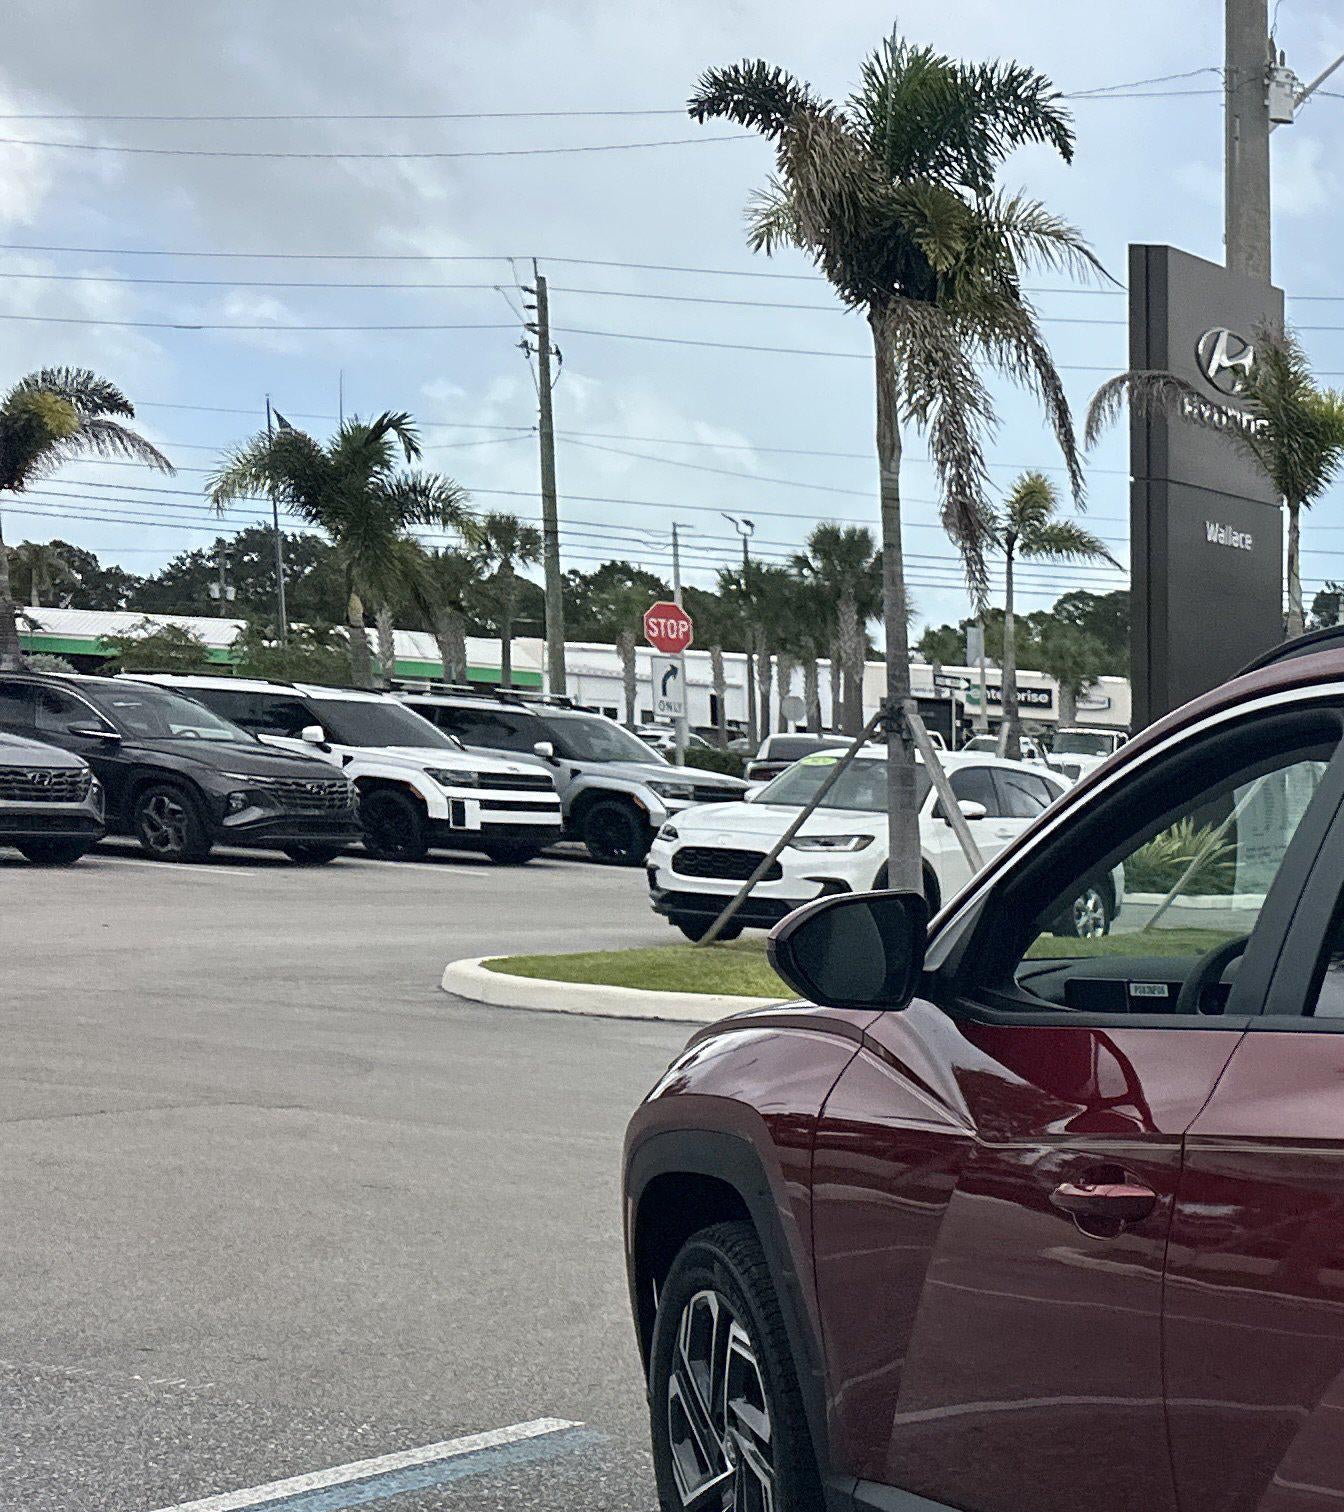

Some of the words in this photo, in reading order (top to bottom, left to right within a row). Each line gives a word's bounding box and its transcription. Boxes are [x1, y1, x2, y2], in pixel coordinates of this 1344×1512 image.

[1183, 397, 1276, 441] HYUND
[1205, 520, 1252, 551] Wallace
[647, 618, 689, 640] STOP
[967, 688, 1049, 703] enterise
